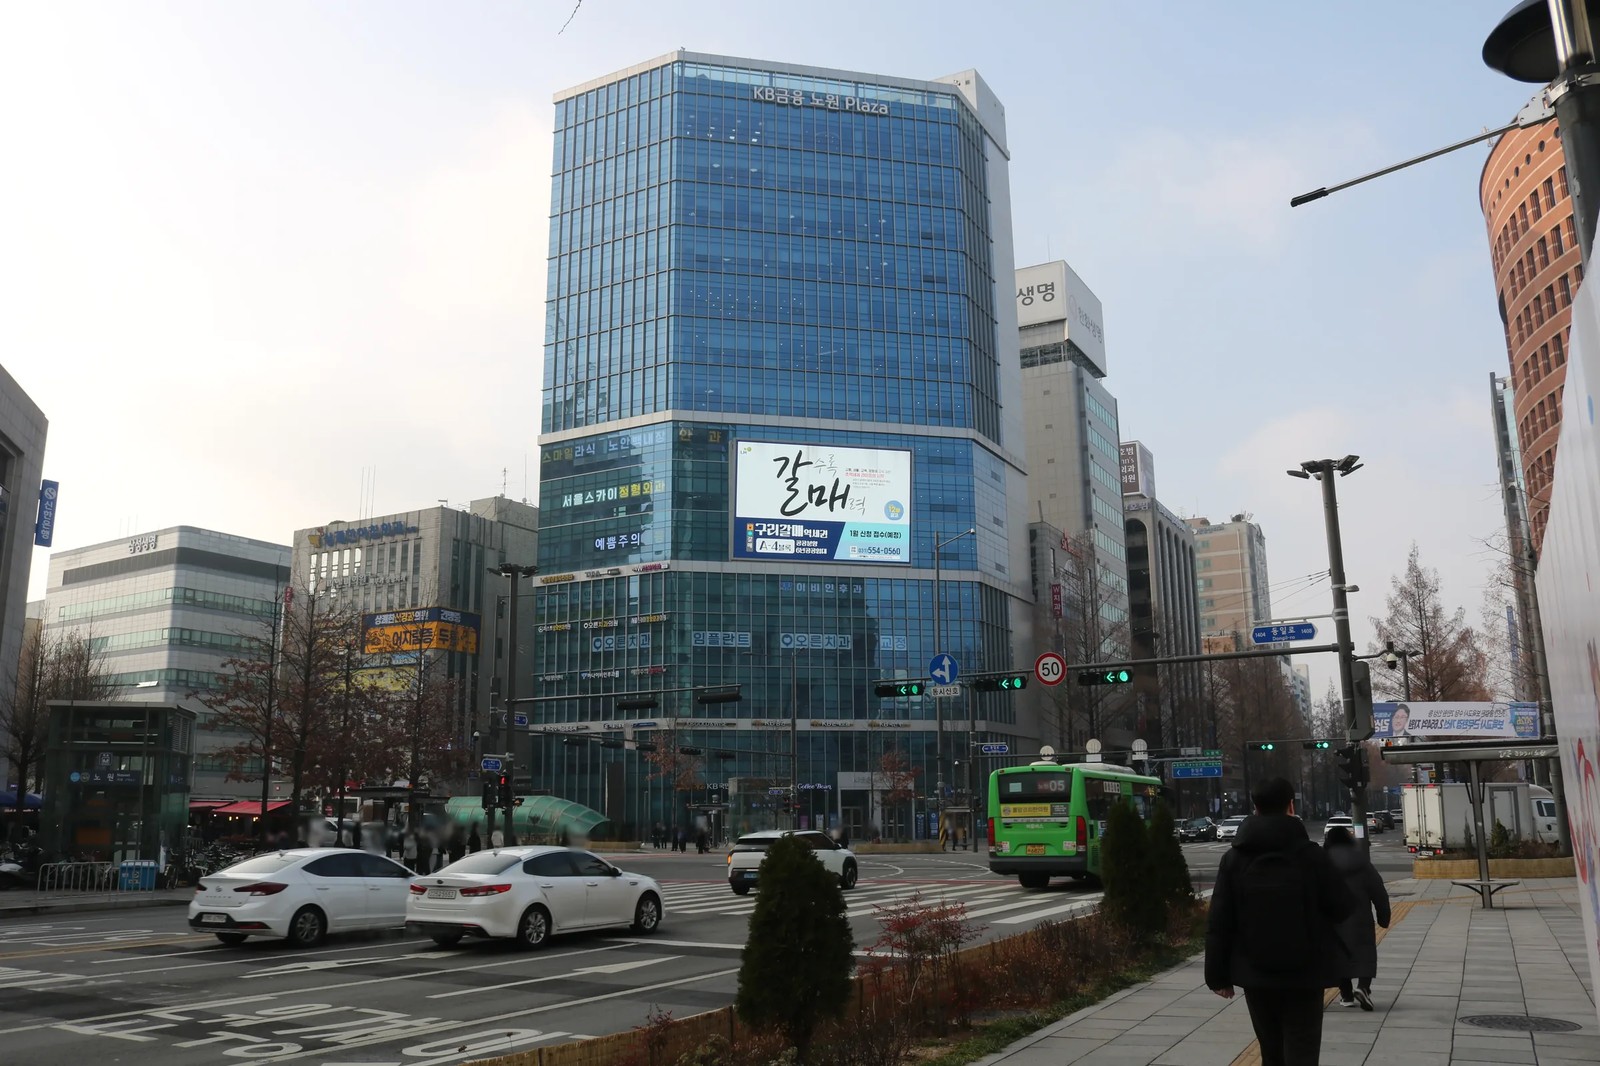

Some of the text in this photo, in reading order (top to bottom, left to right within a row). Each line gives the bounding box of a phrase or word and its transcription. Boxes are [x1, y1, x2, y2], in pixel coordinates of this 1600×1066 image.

[753, 86, 888, 115] KB금융 노원 Plaza
[1016, 281, 1056, 306] 생명
[41, 501, 53, 540] 신한은행
[796, 581, 863, 594] 이비인후과
[604, 633, 650, 650] 오른치과
[693, 632, 749, 647] 임플란트
[795, 635, 850, 650] 오른치과
[1041, 662, 1060, 677] 50
